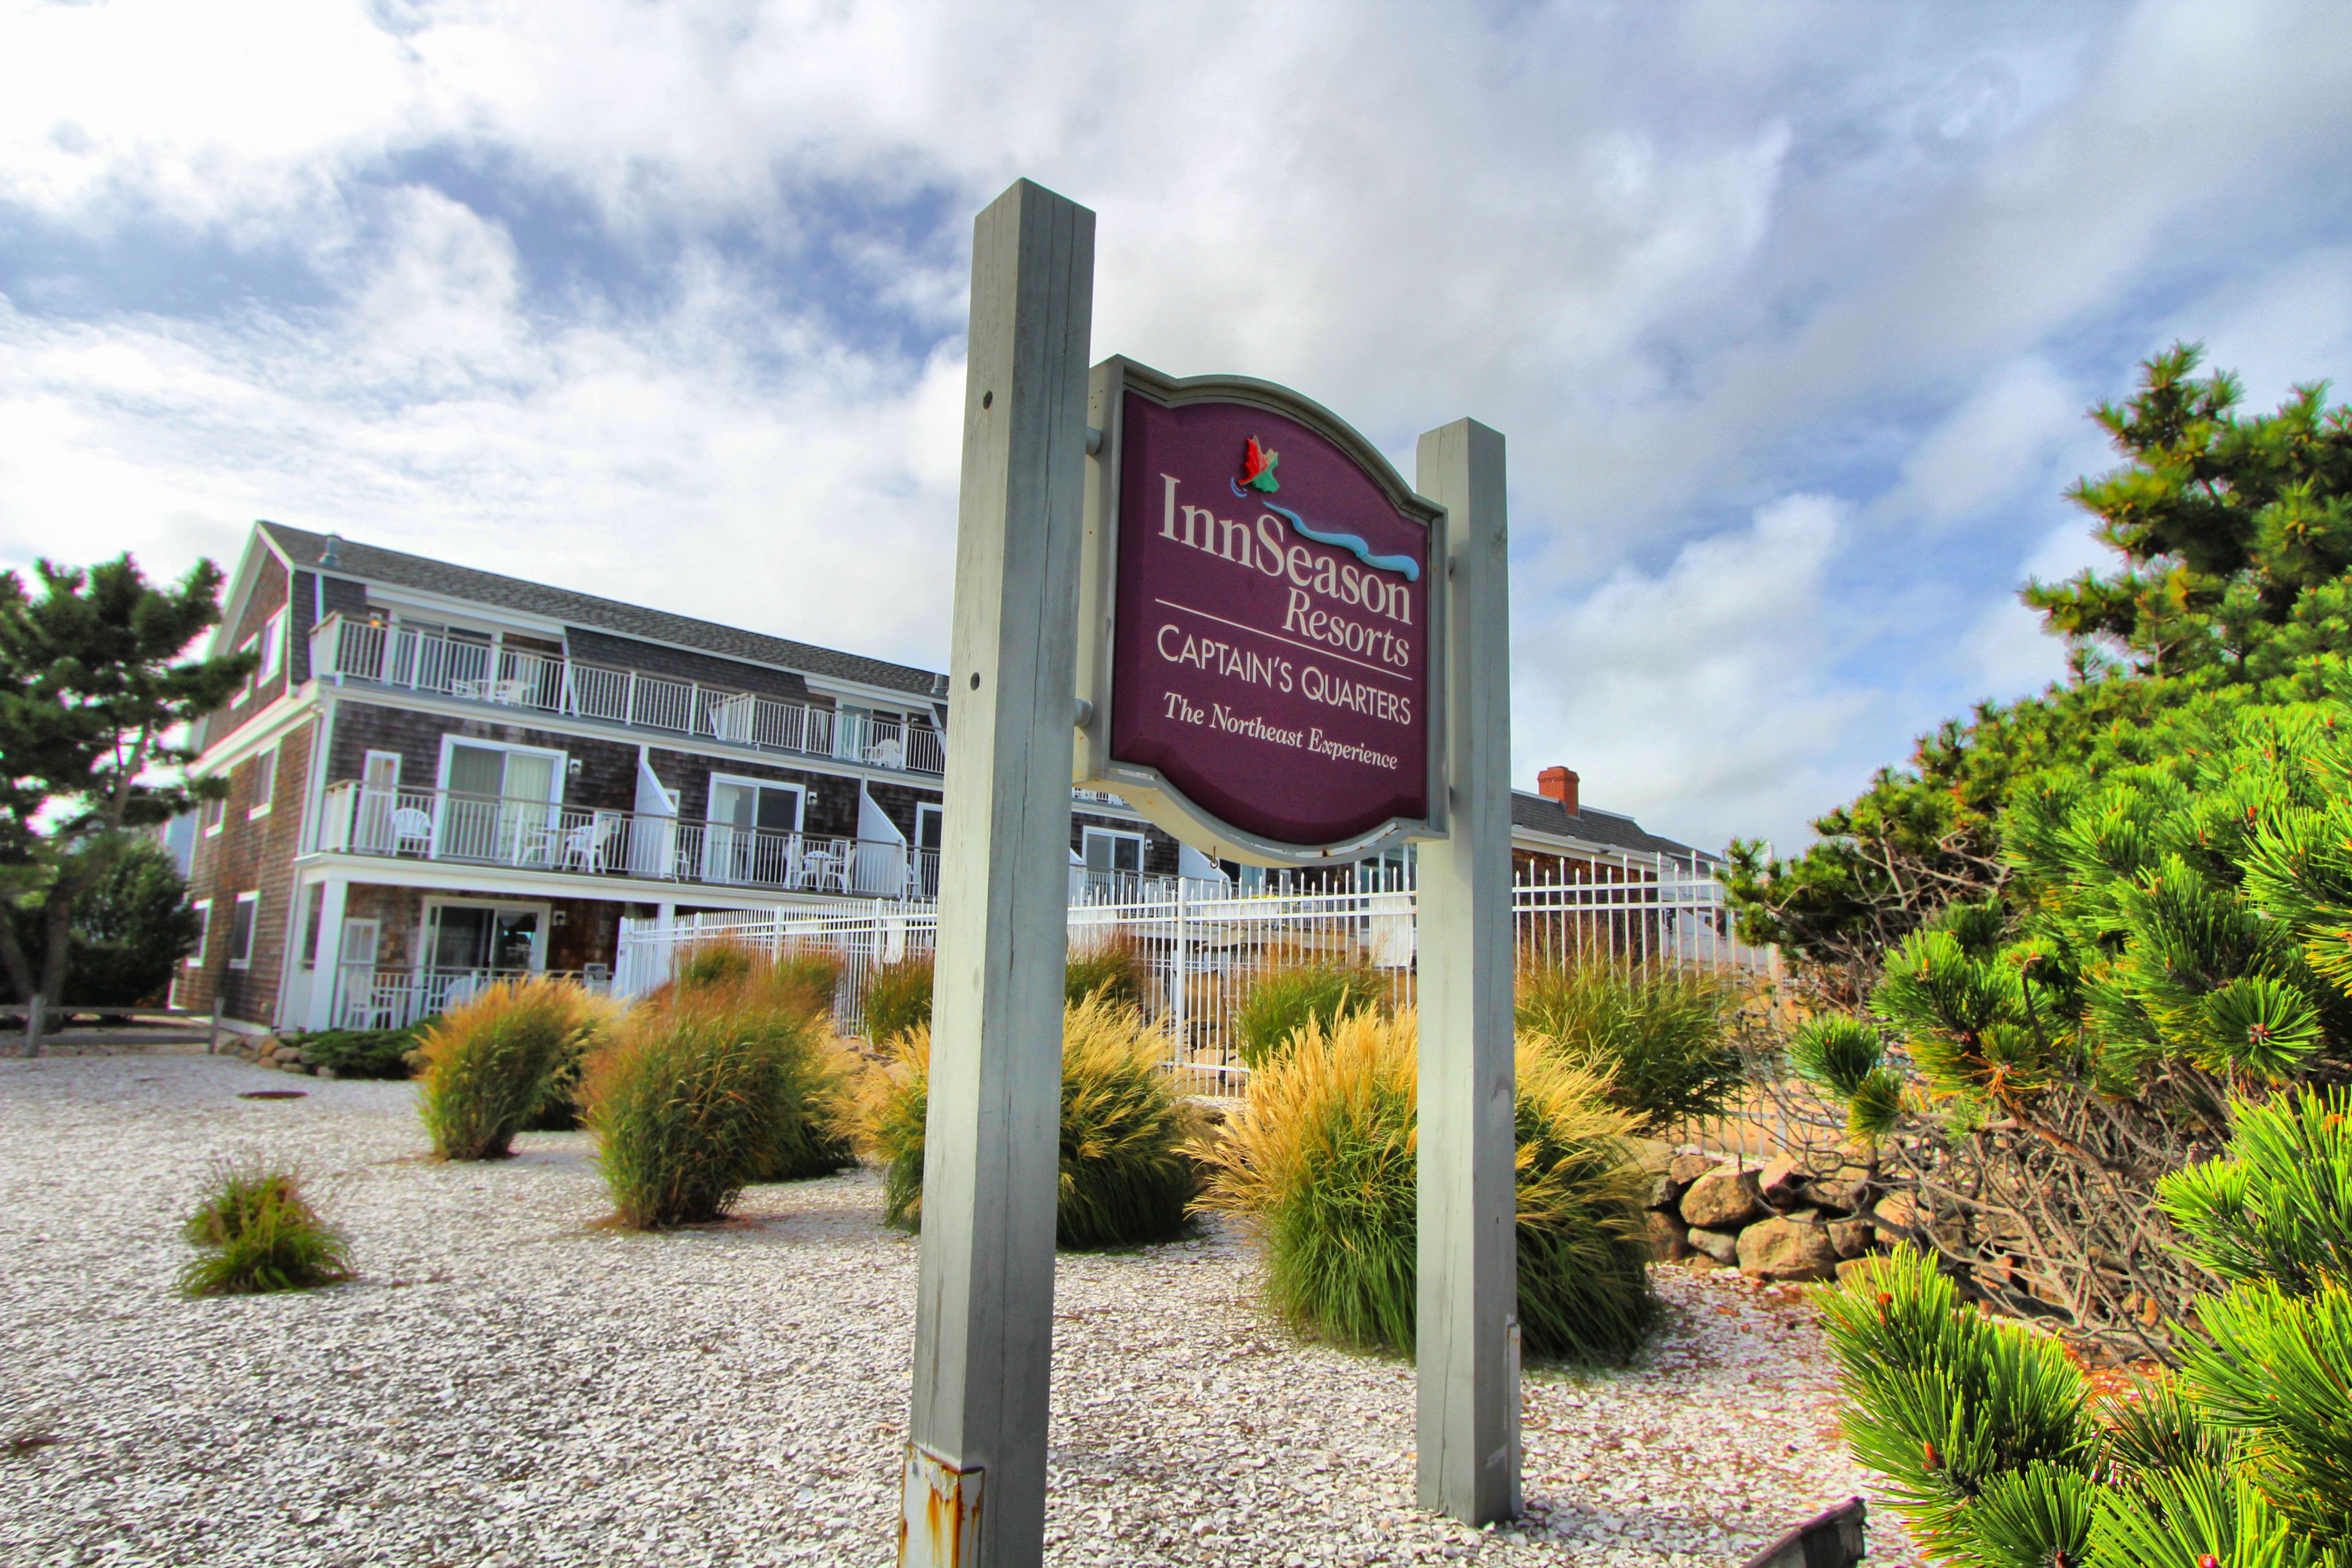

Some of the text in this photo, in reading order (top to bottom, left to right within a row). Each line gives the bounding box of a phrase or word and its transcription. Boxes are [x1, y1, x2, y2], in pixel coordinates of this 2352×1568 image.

[1158, 472, 1413, 626] InnSeason
[1281, 586, 1410, 668] Resorts
[1156, 624, 1411, 726] CAPTAIN'S QUARTERS
[1163, 691, 1398, 770] The Northeast Experience
